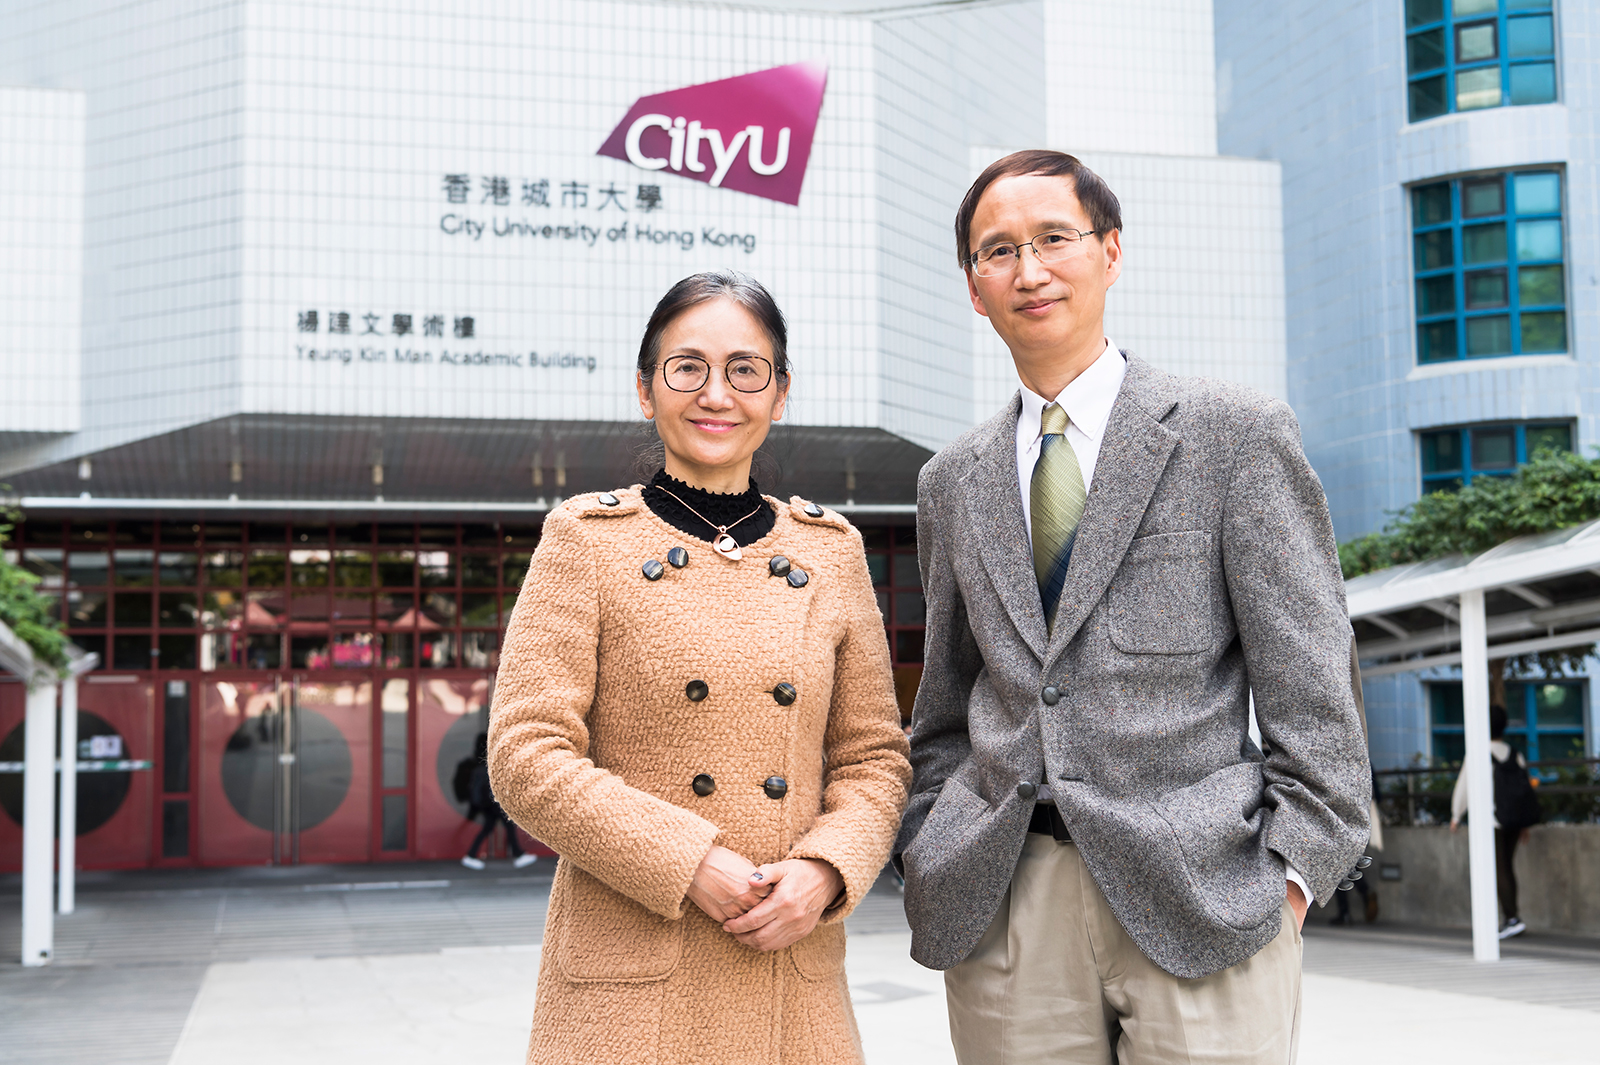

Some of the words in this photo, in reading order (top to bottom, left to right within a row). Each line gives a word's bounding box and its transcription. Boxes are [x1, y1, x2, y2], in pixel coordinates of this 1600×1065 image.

[625, 113, 791, 188] CityU
[441, 174, 664, 213] 香港城市大學
[440, 214, 485, 240] City
[493, 217, 600, 245] University
[606, 221, 629, 242] of
[635, 224, 695, 251] Hong
[702, 227, 756, 253] Kong
[297, 310, 476, 339] 楊建文學術樓
[296, 345, 353, 366] Yeung
[359, 346, 387, 363] Kin
[394, 348, 433, 364] Man
[440, 350, 522, 368] Academic
[529, 352, 597, 373] Building
